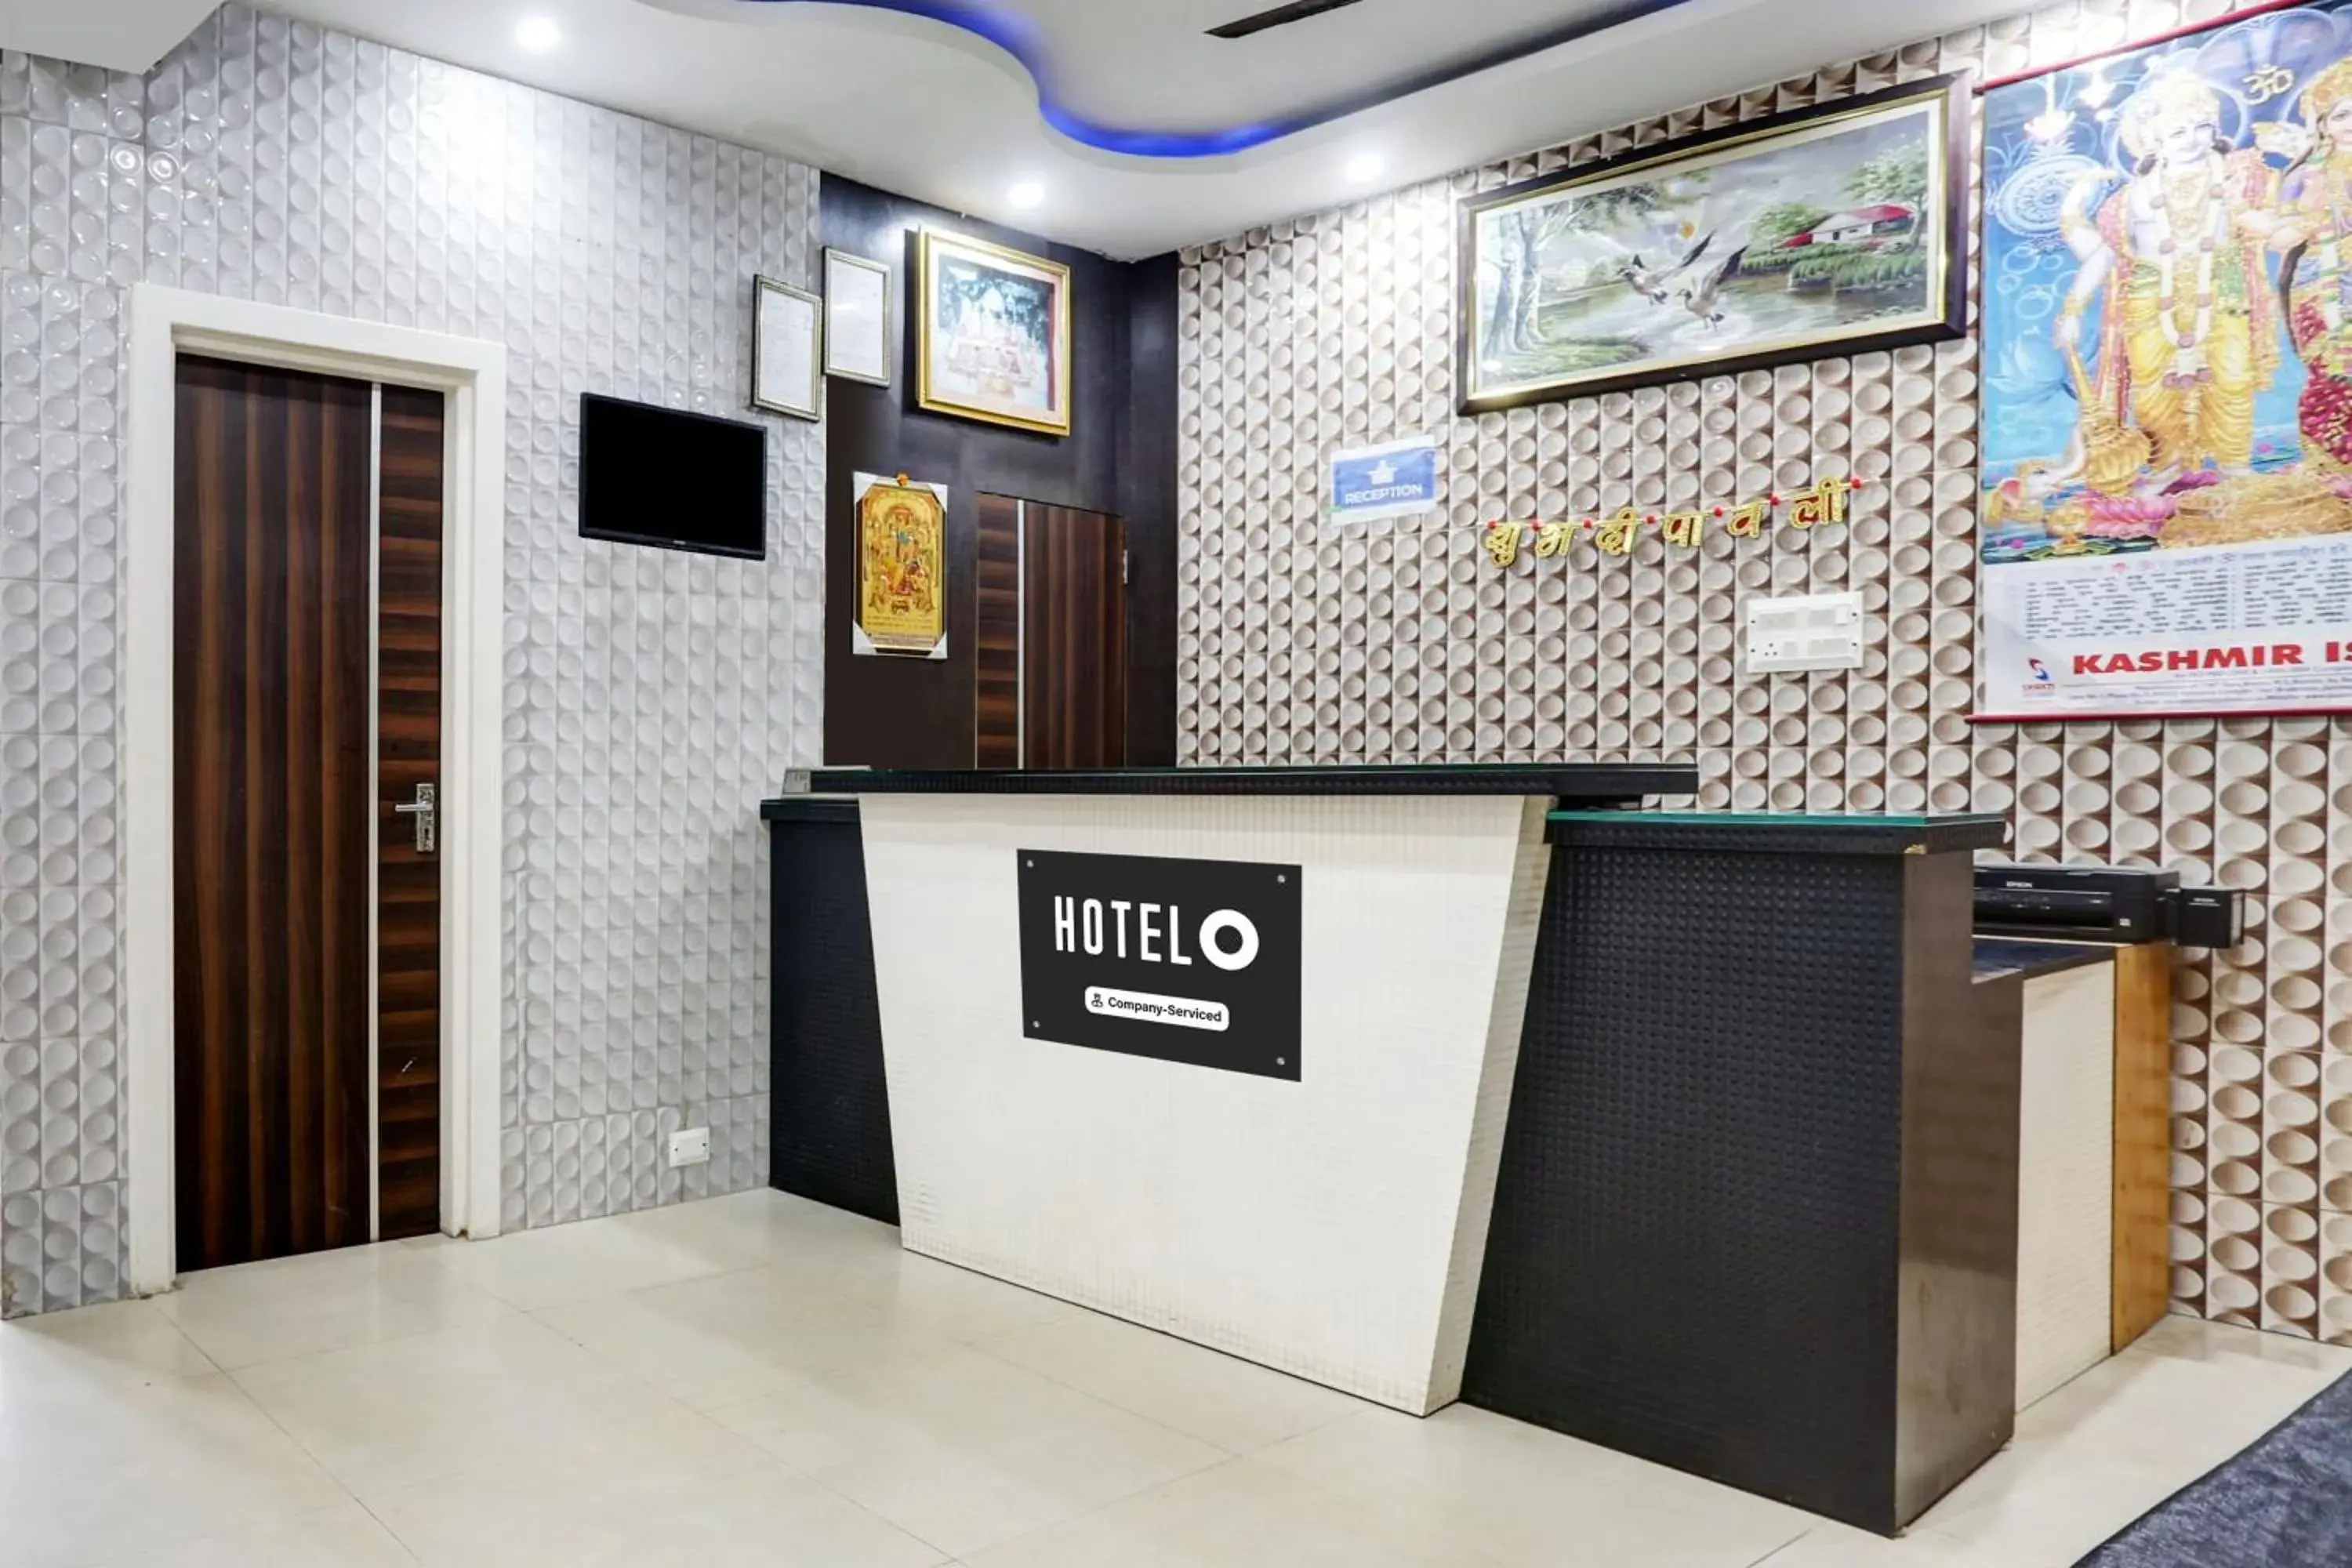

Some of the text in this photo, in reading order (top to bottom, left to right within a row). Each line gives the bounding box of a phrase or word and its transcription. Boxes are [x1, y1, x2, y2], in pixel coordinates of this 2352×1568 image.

[1345, 483, 1423, 505] RECEPTION
[2073, 644, 2303, 674] KASHMIR
[1108, 996, 1222, 1022] Company-Serviced
